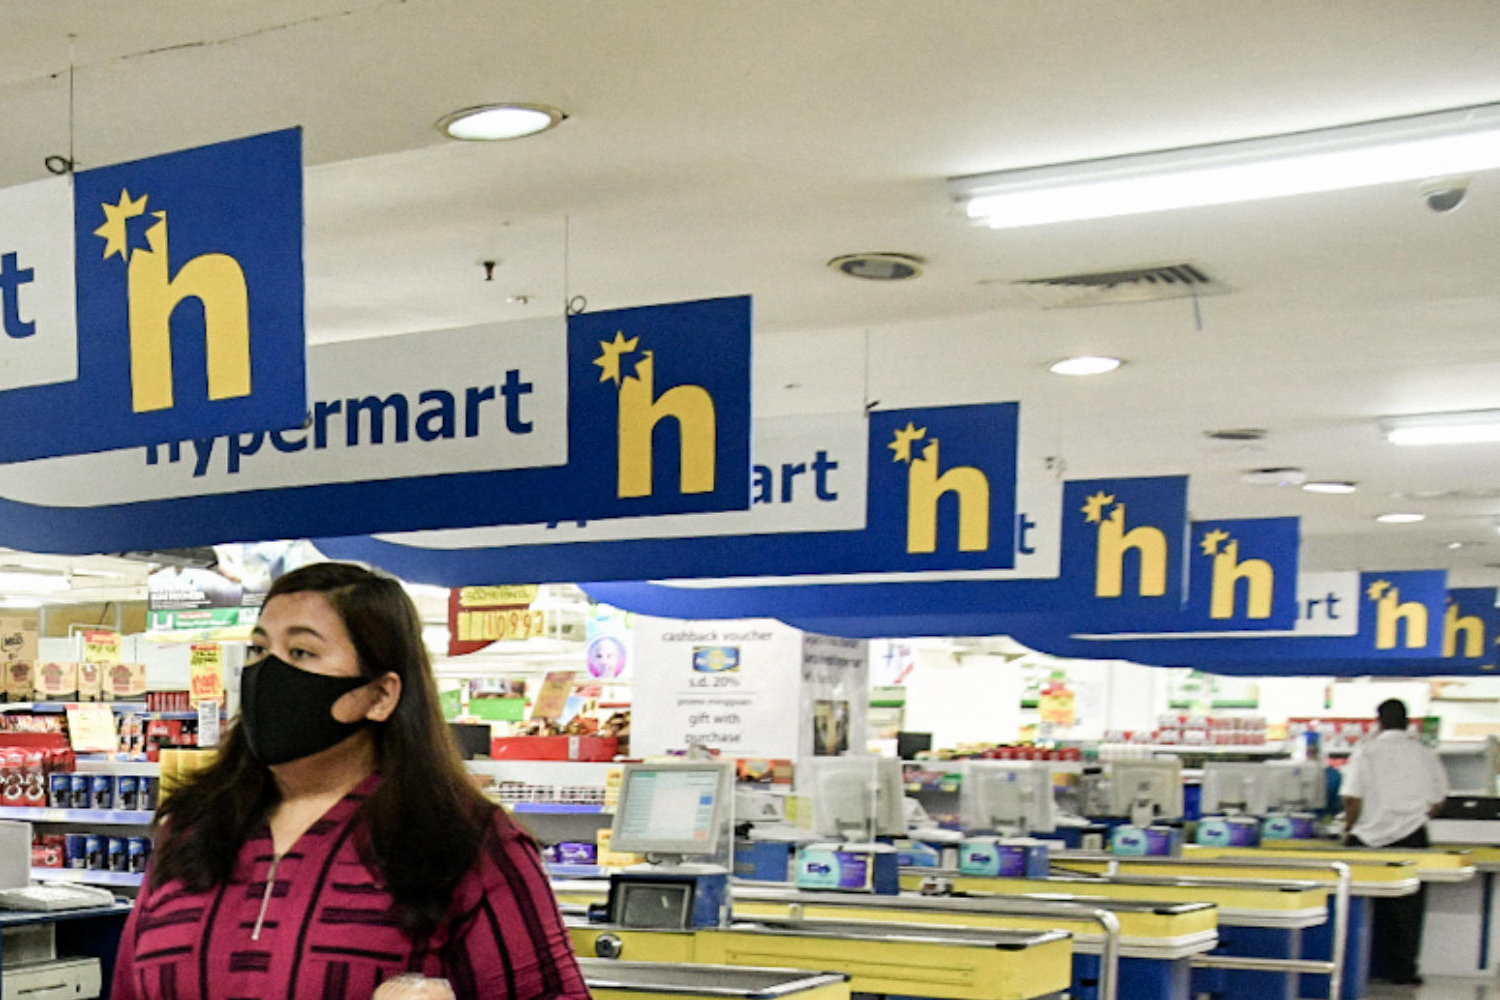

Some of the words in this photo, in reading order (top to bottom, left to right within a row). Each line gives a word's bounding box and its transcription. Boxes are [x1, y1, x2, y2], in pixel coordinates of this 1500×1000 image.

[661, 631, 718, 643] cashback
[722, 630, 774, 642] voucher
[688, 713, 710, 728] gift
[713, 712, 741, 725] with
[684, 731, 742, 746] purchase
